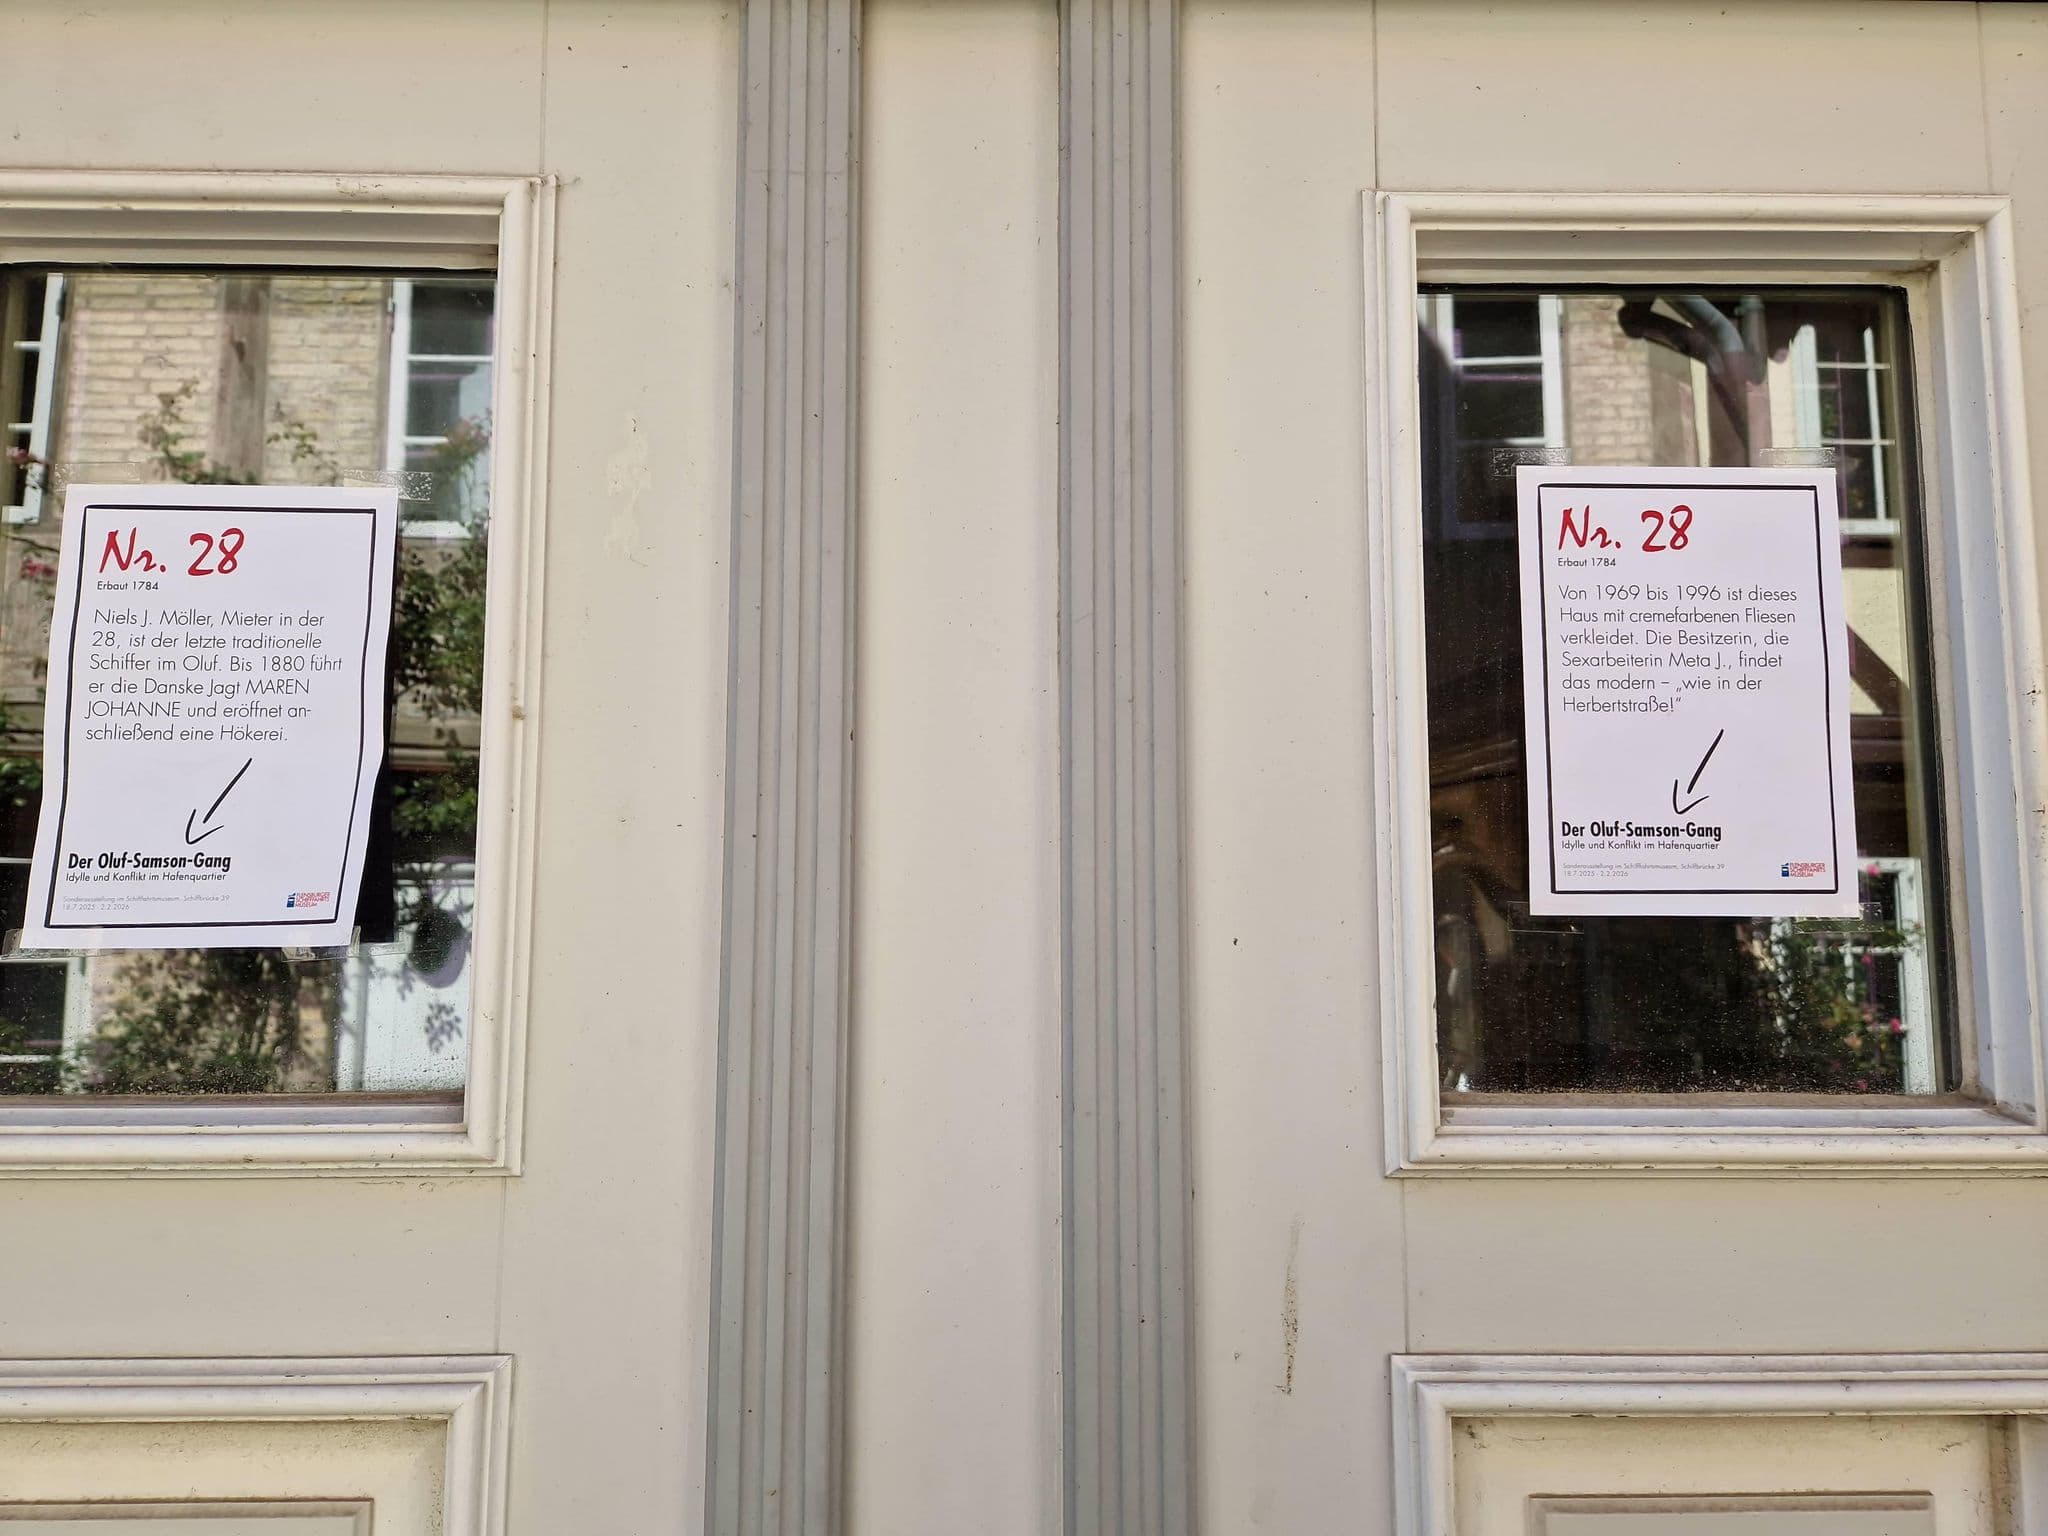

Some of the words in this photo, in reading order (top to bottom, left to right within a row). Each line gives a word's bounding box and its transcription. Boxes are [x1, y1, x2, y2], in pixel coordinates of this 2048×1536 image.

[1558, 505, 1621, 550] Nr.
[1641, 505, 1693, 552] 28
[99, 527, 167, 574] Nr.
[187, 528, 245, 576] 28
[1558, 558, 1587, 567] Erbaut
[1591, 558, 1616, 567] 1784
[97, 581, 128, 591] Erbaut
[133, 581, 159, 591] 1784
[1558, 584, 1587, 600] Von
[1596, 584, 1640, 600] 1969
[1647, 584, 1668, 601] bis
[1677, 585, 1721, 601] 1996
[1727, 587, 1742, 601] ist
[1748, 584, 1797, 601] dieses
[94, 608, 137, 625] Niels
[141, 609, 152, 627] J.
[160, 609, 213, 628] Möller,
[221, 610, 272, 626] Mieter
[280, 612, 292, 626] in
[298, 610, 325, 627] der
[1560, 608, 1598, 622] Haus
[1604, 609, 1624, 622] mit
[1630, 607, 1739, 623] cremefarbenen
[1745, 608, 1796, 623] Fliesen
[92, 631, 120, 649] 28,
[129, 634, 145, 647] ist
[152, 632, 179, 648] der
[185, 632, 226, 648] letzte
[232, 633, 322, 649] traditionelle
[1560, 629, 1638, 645] verkleidet.
[1646, 631, 1672, 645] Die
[1679, 631, 1757, 647] Besitzerin,
[1763, 629, 1789, 645] die
[89, 653, 150, 670] Schiffer
[158, 657, 175, 671] im
[183, 654, 221, 671] Oluf.
[230, 655, 252, 671] Bis
[262, 655, 304, 671] 1880
[310, 654, 342, 672] führt
[1561, 651, 1663, 667] Sexarbeiterin
[1669, 653, 1710, 667] Meta
[1715, 653, 1731, 670] J.,
[1739, 652, 1782, 667] findet
[89, 681, 104, 693] er
[111, 678, 137, 694] die
[145, 678, 203, 694] Danske
[208, 679, 240, 699] Jagt
[245, 679, 310, 694] MAREN
[1562, 674, 1590, 690] das
[1597, 674, 1655, 690] modern
[1676, 677, 1711, 692] „wie
[1718, 676, 1730, 690] in
[1736, 674, 1762, 690] der
[85, 701, 180, 719] JOHANNE
[188, 701, 216, 717] und
[223, 701, 282, 718] eröffnet
[287, 705, 311, 718] an-
[86, 723, 173, 741] schließend
[180, 726, 213, 741] eine
[220, 725, 287, 741] Hökerei.
[1562, 821, 1584, 837] Der
[1591, 821, 1722, 842] Oluf-Samson-Gang
[1562, 841, 1585, 850] Idylle
[1589, 840, 1604, 849] und
[1608, 840, 1641, 849] Konflikt
[1644, 841, 1654, 849] im
[1658, 840, 1719, 851] Hafenquartier
[68, 853, 93, 869] Der
[98, 852, 231, 872] Oluf-Samson-Gang
[66, 872, 90, 883] Idylle
[94, 872, 109, 882] und
[113, 872, 146, 881] Konflikt
[149, 872, 159, 881] im
[163, 872, 226, 882] Hafenquartier
